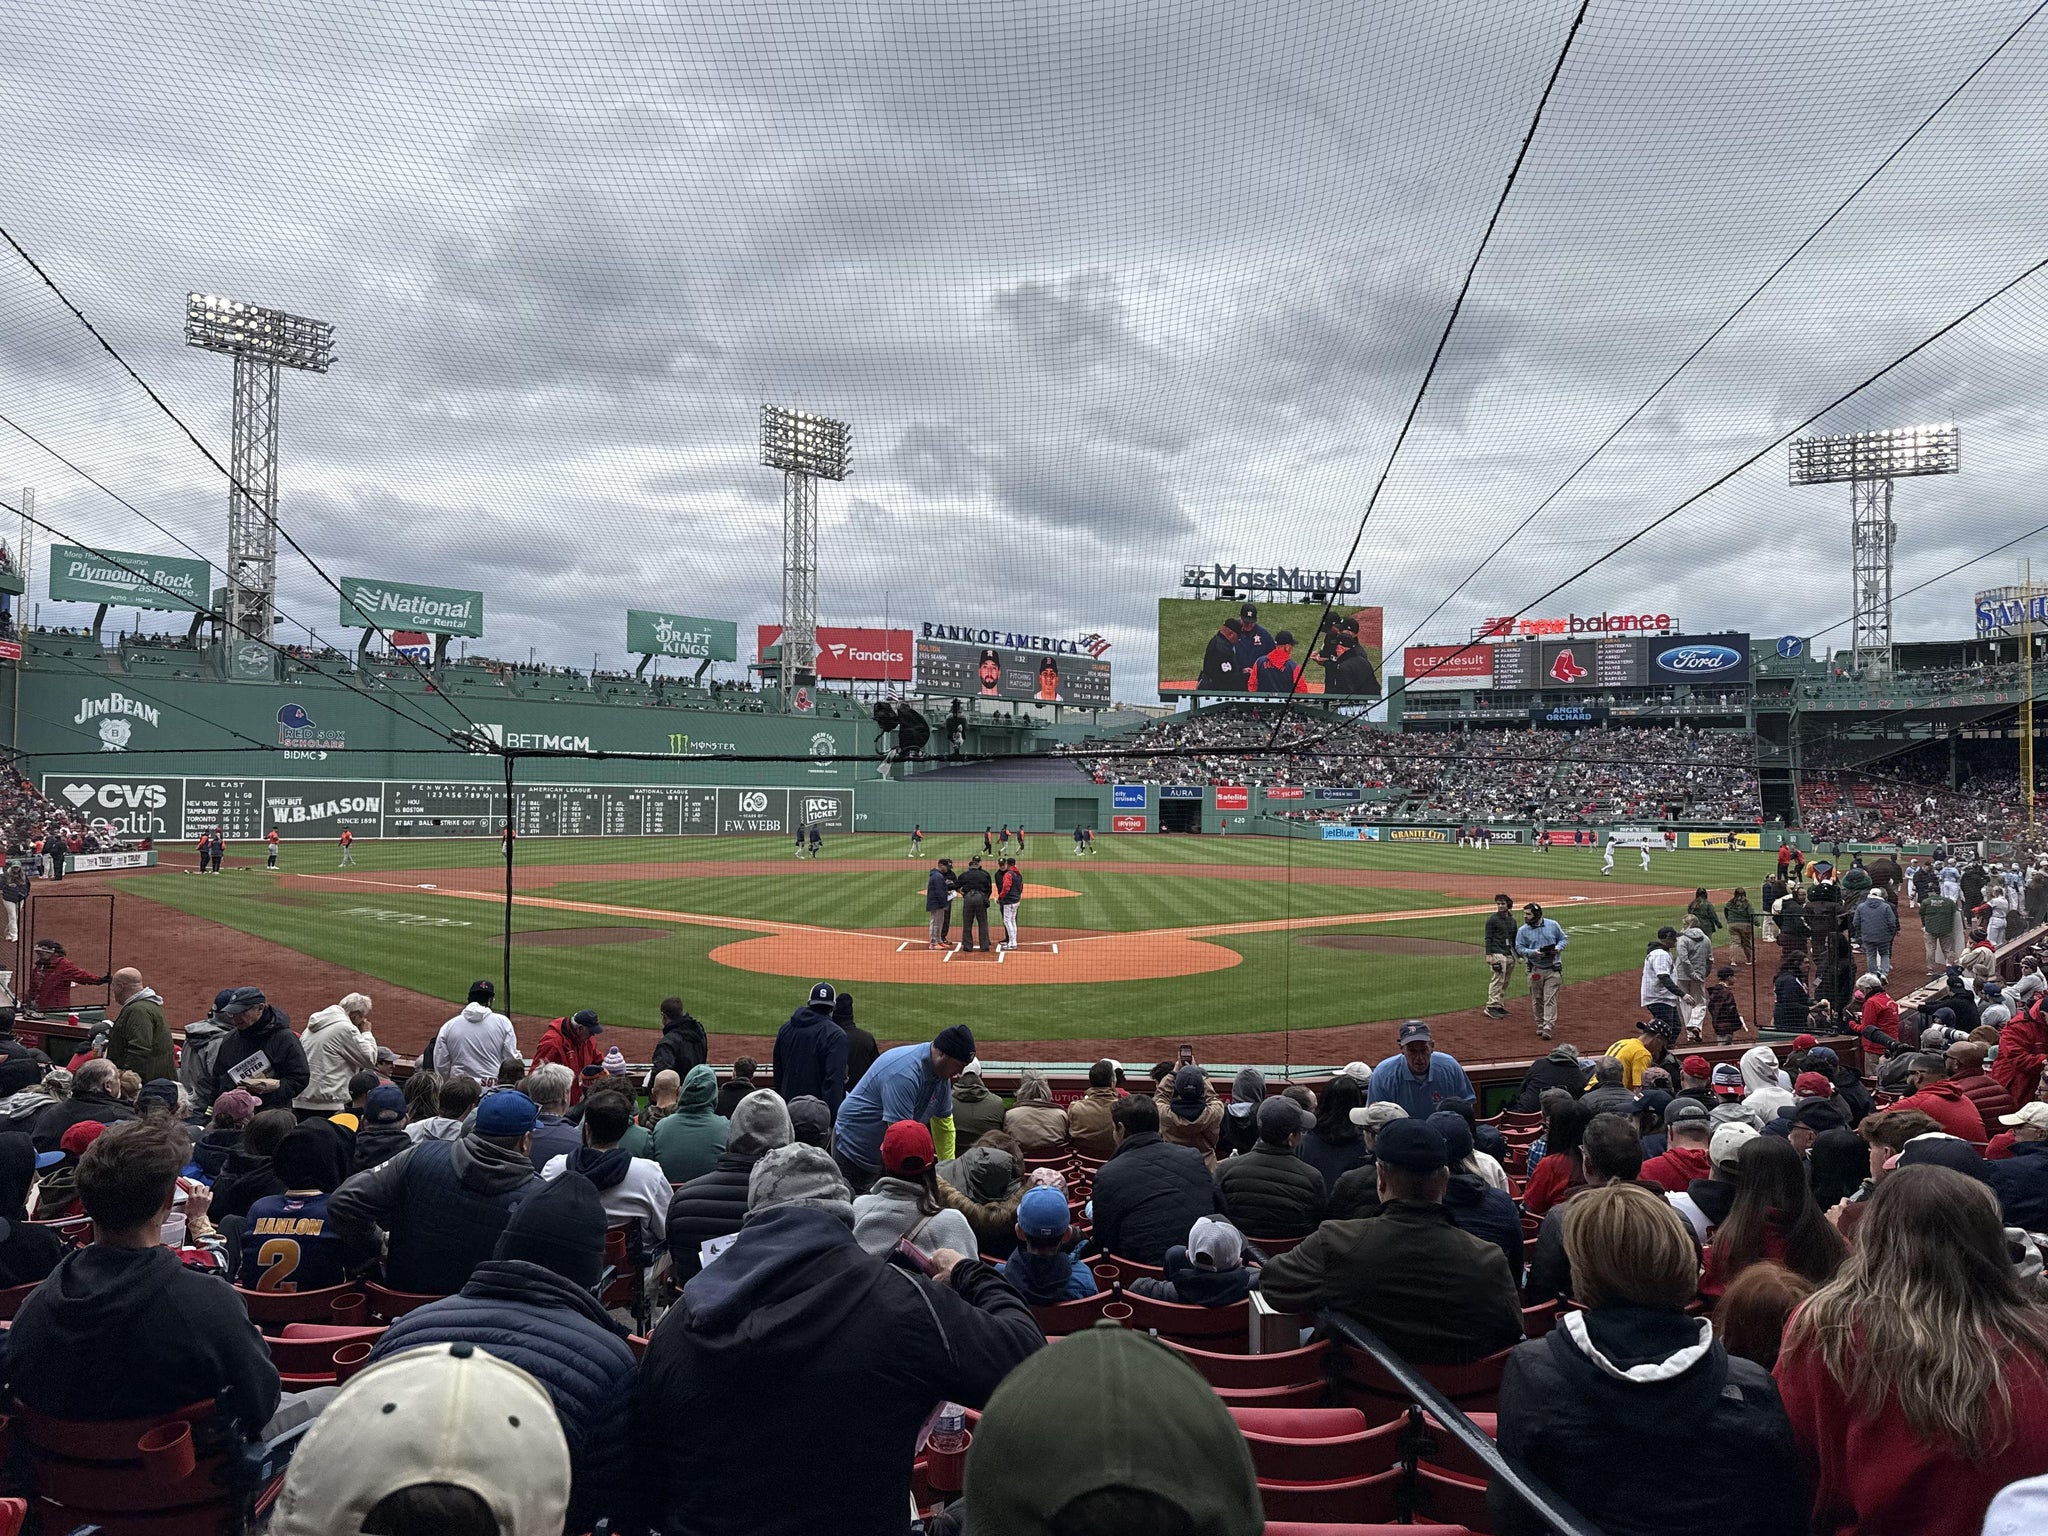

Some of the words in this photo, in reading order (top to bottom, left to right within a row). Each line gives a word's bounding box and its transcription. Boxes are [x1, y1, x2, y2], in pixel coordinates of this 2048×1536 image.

[68, 561, 150, 585] Plymouth
[152, 570, 194, 588] Rock
[1215, 563, 1361, 594] MassMutual
[412, 616, 431, 626] Car
[434, 618, 466, 628] Rental
[1520, 619, 1567, 634] new
[1570, 612, 1670, 632] balance
[656, 629, 712, 645] DRAFT
[924, 622, 973, 642] BANK
[979, 629, 1000, 644] OF
[1005, 632, 1077, 654] AMERICA
[662, 641, 709, 656] KINGS
[850, 648, 904, 662] Fanatics
[1413, 655, 1484, 667] CLEAResult
[1673, 650, 1724, 668] Ford
[284, 729, 314, 739] RED
[316, 730, 346, 740] SOX
[284, 739, 345, 749] SCHOLARS
[507, 733, 590, 751] BETMGM
[284, 751, 316, 760] BIDMC
[98, 784, 167, 808] CVS
[739, 792, 768, 812] 160
[808, 799, 838, 812] ACE
[810, 810, 838, 820] TICKET
[724, 820, 745, 831] F.W.
[748, 820, 780, 831] WEBB
[1325, 829, 1354, 838] jetBlue
[1391, 830, 1426, 839] GRANITE
[1428, 830, 1447, 840] CITY
[1491, 832, 1516, 840] asabi
[1702, 838, 1730, 847] TWISTE
[820, 989, 827, 997] S
[240, 1062, 264, 1080] BETTER
[253, 1218, 324, 1236] HANLON
[256, 1238, 301, 1293] 2
